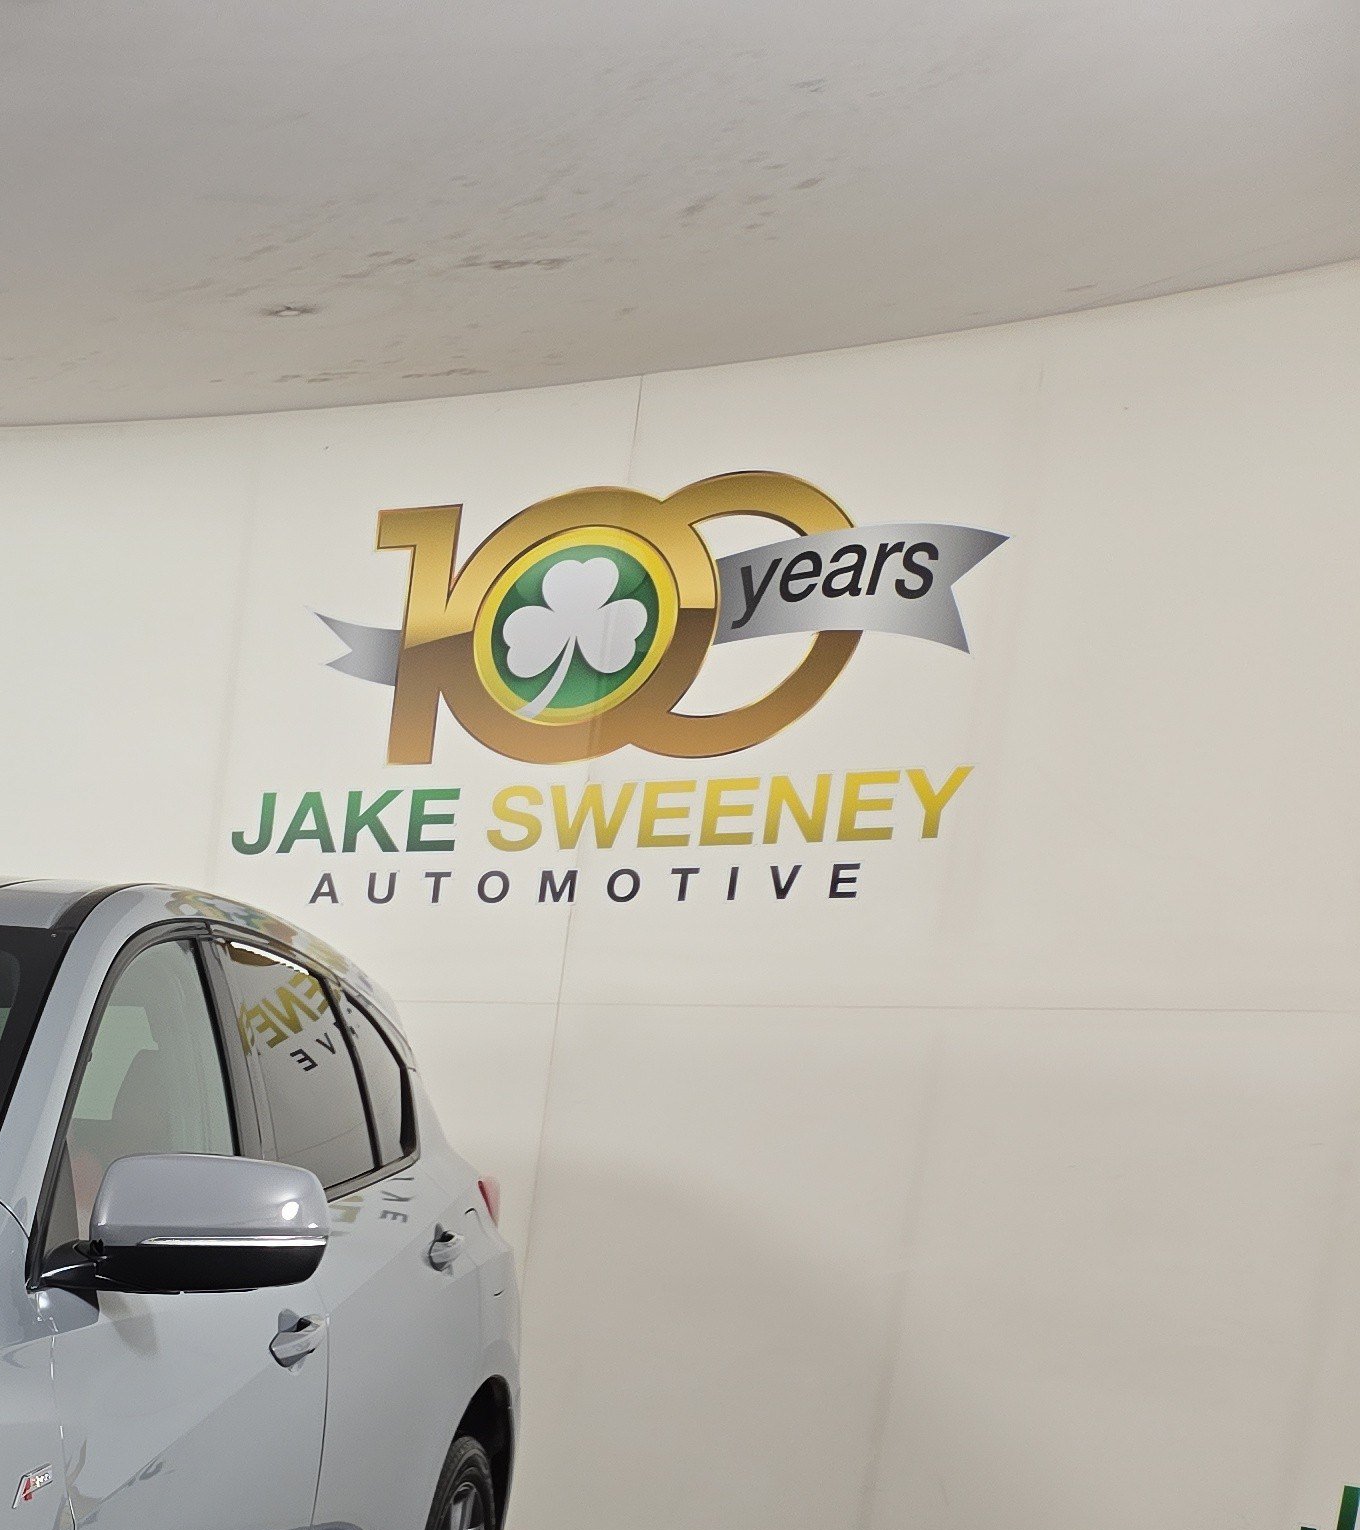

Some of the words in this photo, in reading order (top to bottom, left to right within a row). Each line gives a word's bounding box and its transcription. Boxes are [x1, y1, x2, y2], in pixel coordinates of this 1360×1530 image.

[731, 541, 939, 628] years
[231, 788, 462, 856] JAKE
[486, 766, 974, 853] SWEENEY
[309, 862, 862, 905] AUTOMOTIVE
